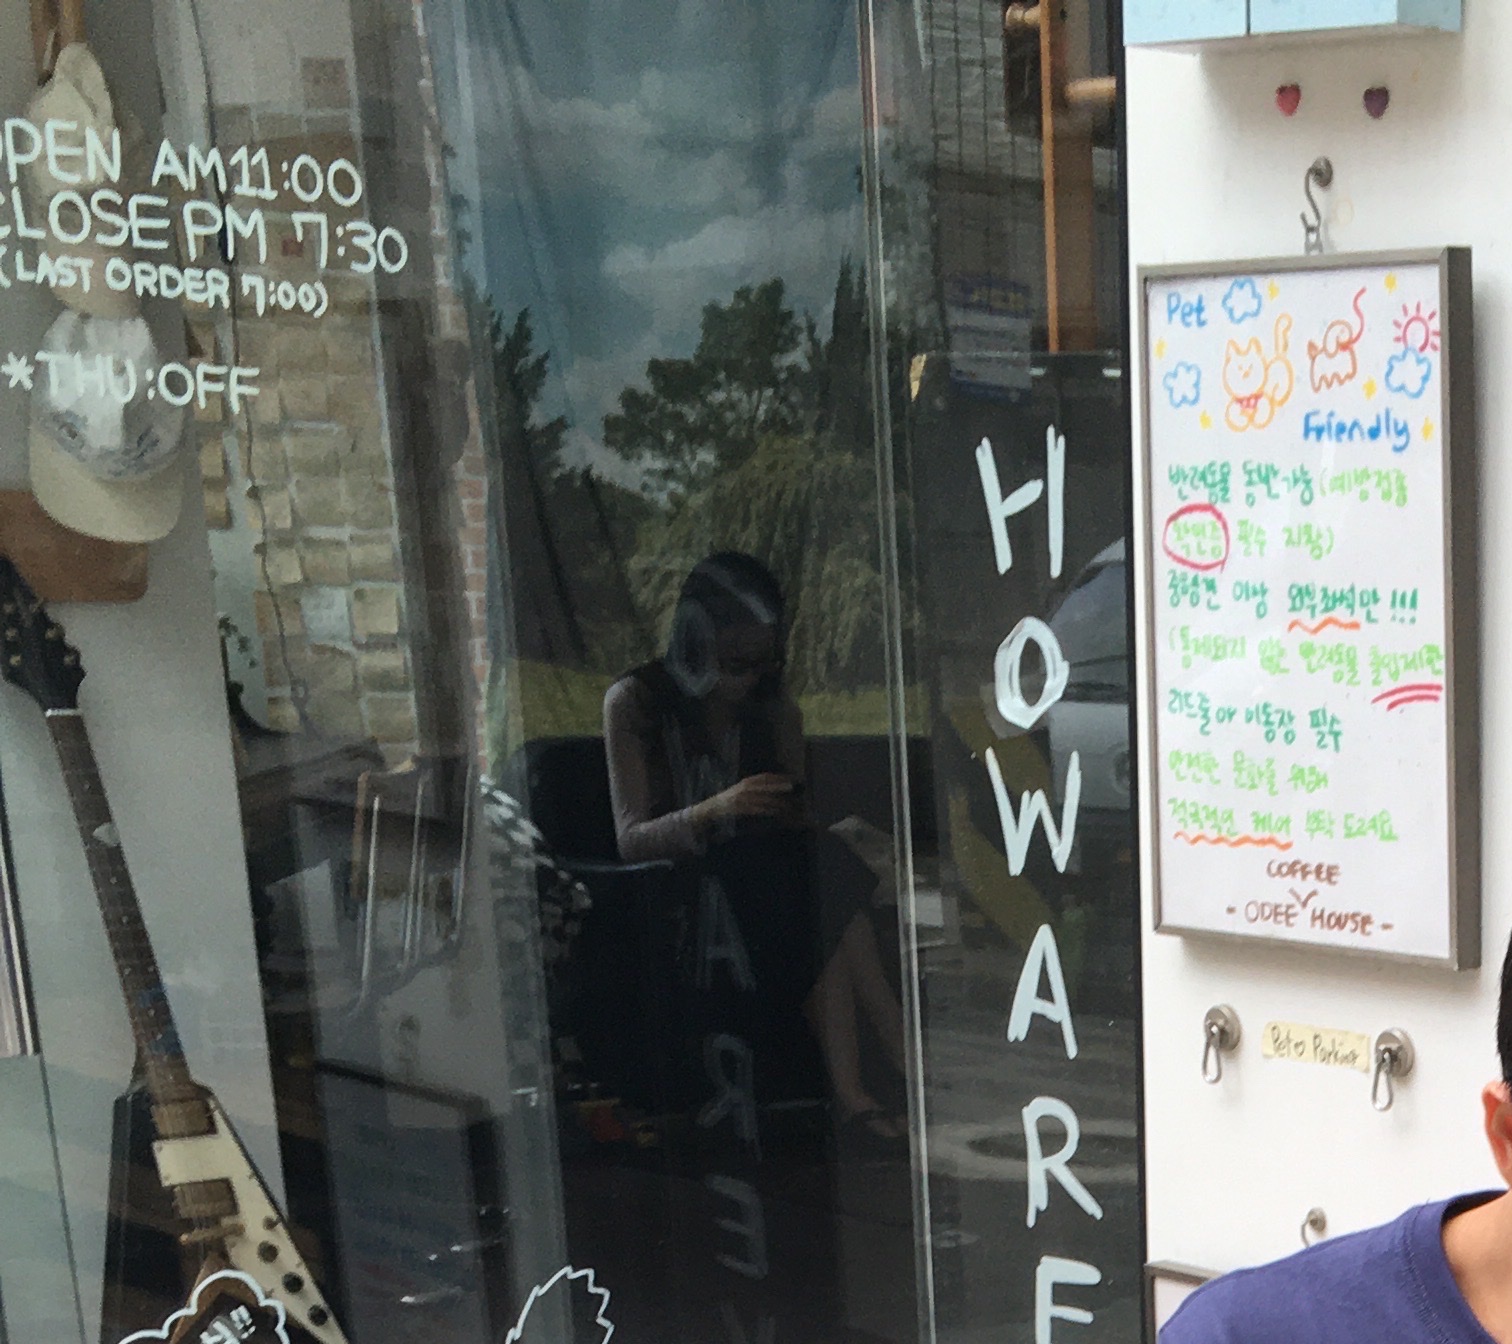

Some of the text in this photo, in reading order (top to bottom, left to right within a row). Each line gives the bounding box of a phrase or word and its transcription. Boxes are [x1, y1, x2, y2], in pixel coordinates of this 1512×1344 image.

[0, 118, 120, 183] PEN
[183, 202, 266, 263] PM
[292, 213, 407, 273] 7:30
[106, 255, 232, 308] ORDER
[242, 274, 327, 317] 7:00)
[1167, 292, 1207, 328] Pet
[1303, 410, 1409, 453] Friendly
[1168, 460, 1232, 506] 반려동물
[1243, 463, 1314, 506] 동반가능
[1238, 519, 1266, 554] 필수
[1234, 581, 1268, 618] 이상
[1169, 688, 1210, 735] 리드줄
[1243, 702, 1297, 746] 이동장
[1310, 708, 1343, 751] 필수
[1267, 859, 1341, 889] COFFEE
[1245, 900, 1374, 936] ODEE HOUSE
[1271, 1025, 1293, 1058] Pet
